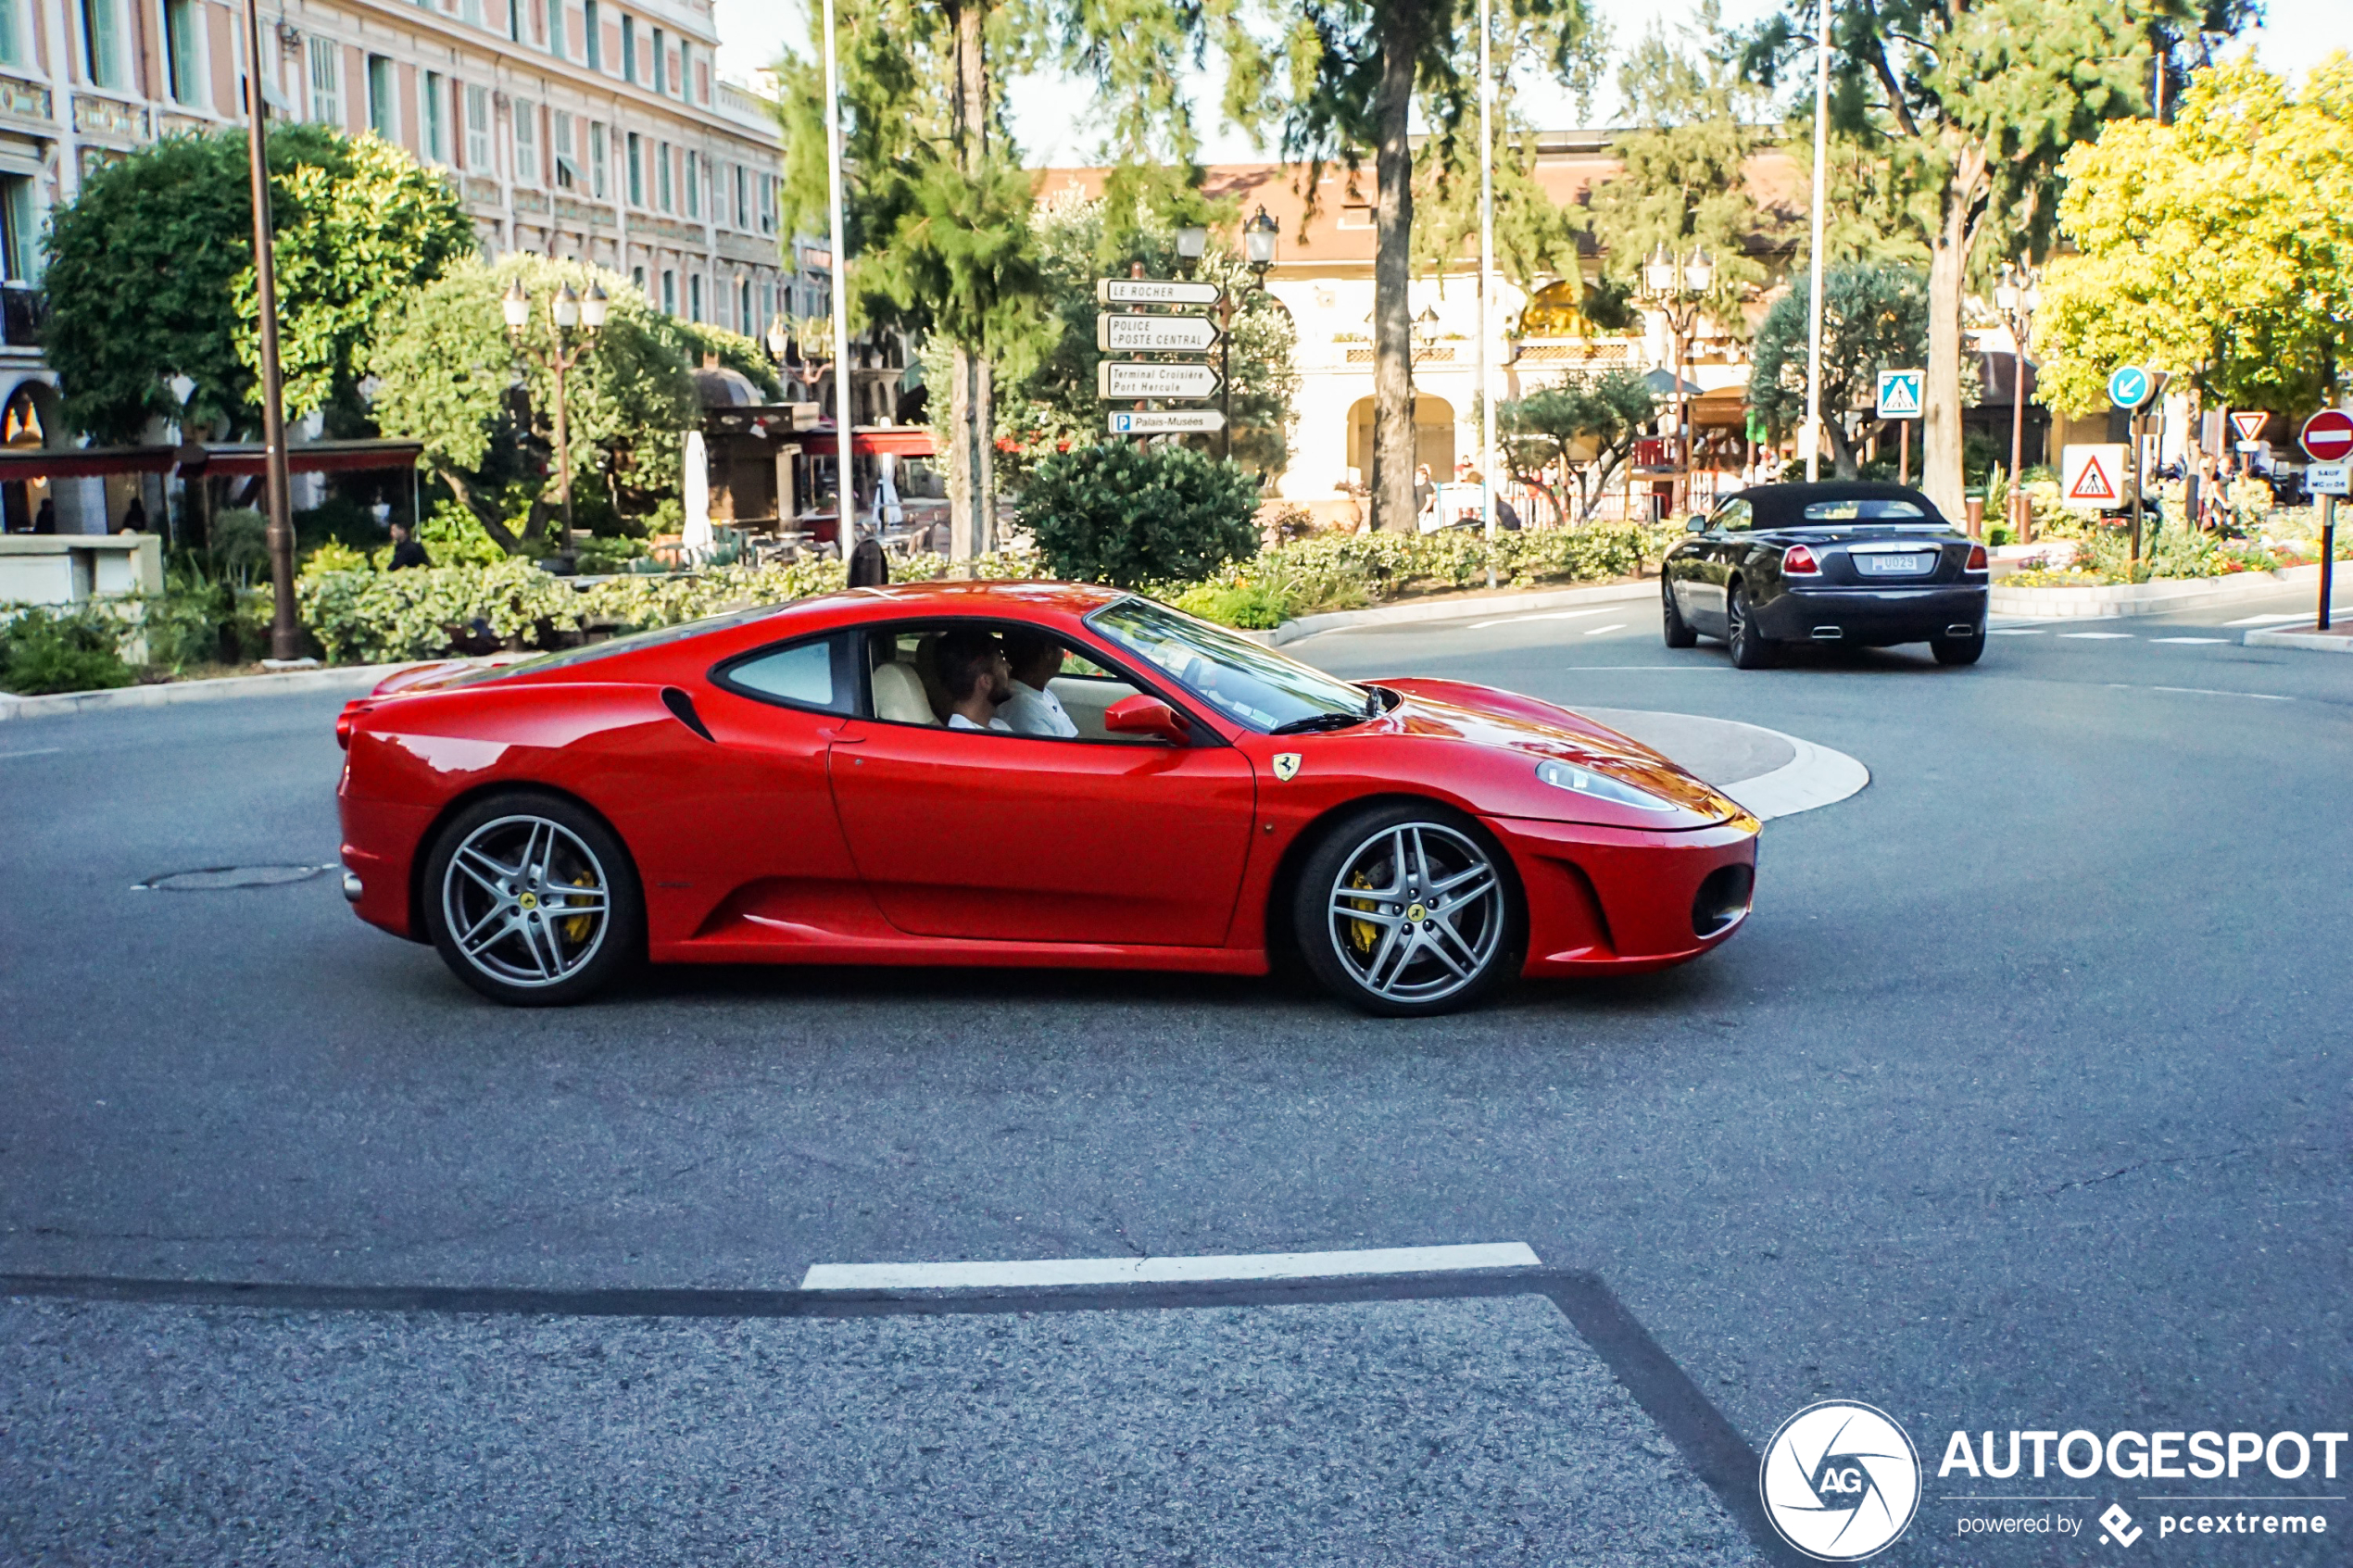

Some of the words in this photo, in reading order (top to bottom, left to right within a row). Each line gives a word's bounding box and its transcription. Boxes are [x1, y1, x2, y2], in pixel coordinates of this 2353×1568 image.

[1114, 285, 1126, 296] LE
[1131, 285, 1174, 296] ROCHER
[1113, 320, 1151, 332] POLICE
[1156, 334, 1202, 345] CENTRAL
[1114, 369, 1155, 379] Terminal
[1159, 369, 1203, 380] Croisière
[1114, 382, 1136, 392] Port
[1141, 382, 1180, 392] Hercule
[1119, 416, 1128, 430] P
[1136, 417, 1203, 427] Palais-Musées
